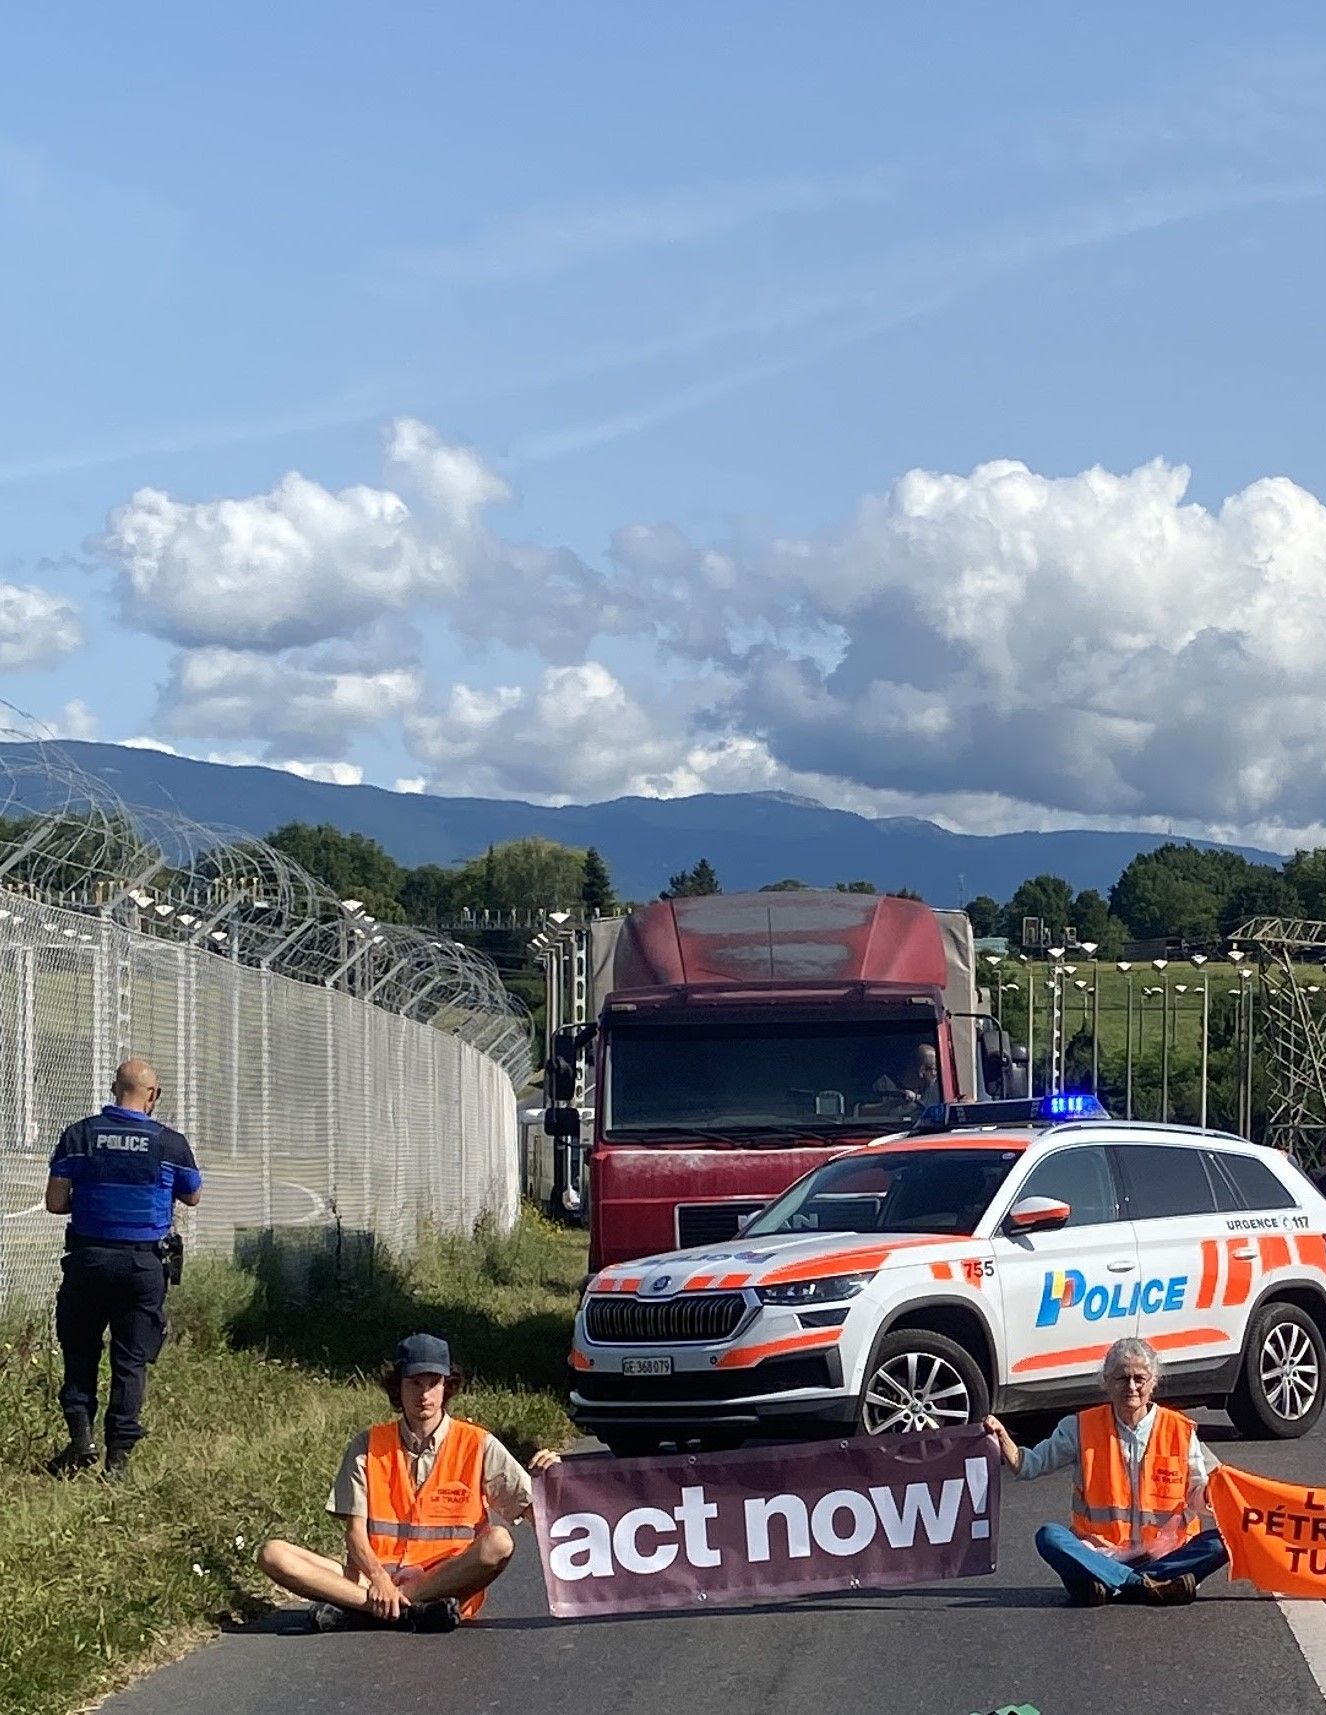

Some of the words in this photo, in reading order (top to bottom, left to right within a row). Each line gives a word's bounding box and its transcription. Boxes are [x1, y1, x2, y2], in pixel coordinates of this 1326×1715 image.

[96, 1134, 150, 1152] POLICE
[1226, 1218, 1279, 1231] URGENCE
[1292, 1216, 1310, 1229] 117
[963, 1260, 995, 1278] 755
[1035, 1269, 1188, 1328] POLICE
[549, 1486, 721, 1581] act
[744, 1457, 991, 1563] now!
